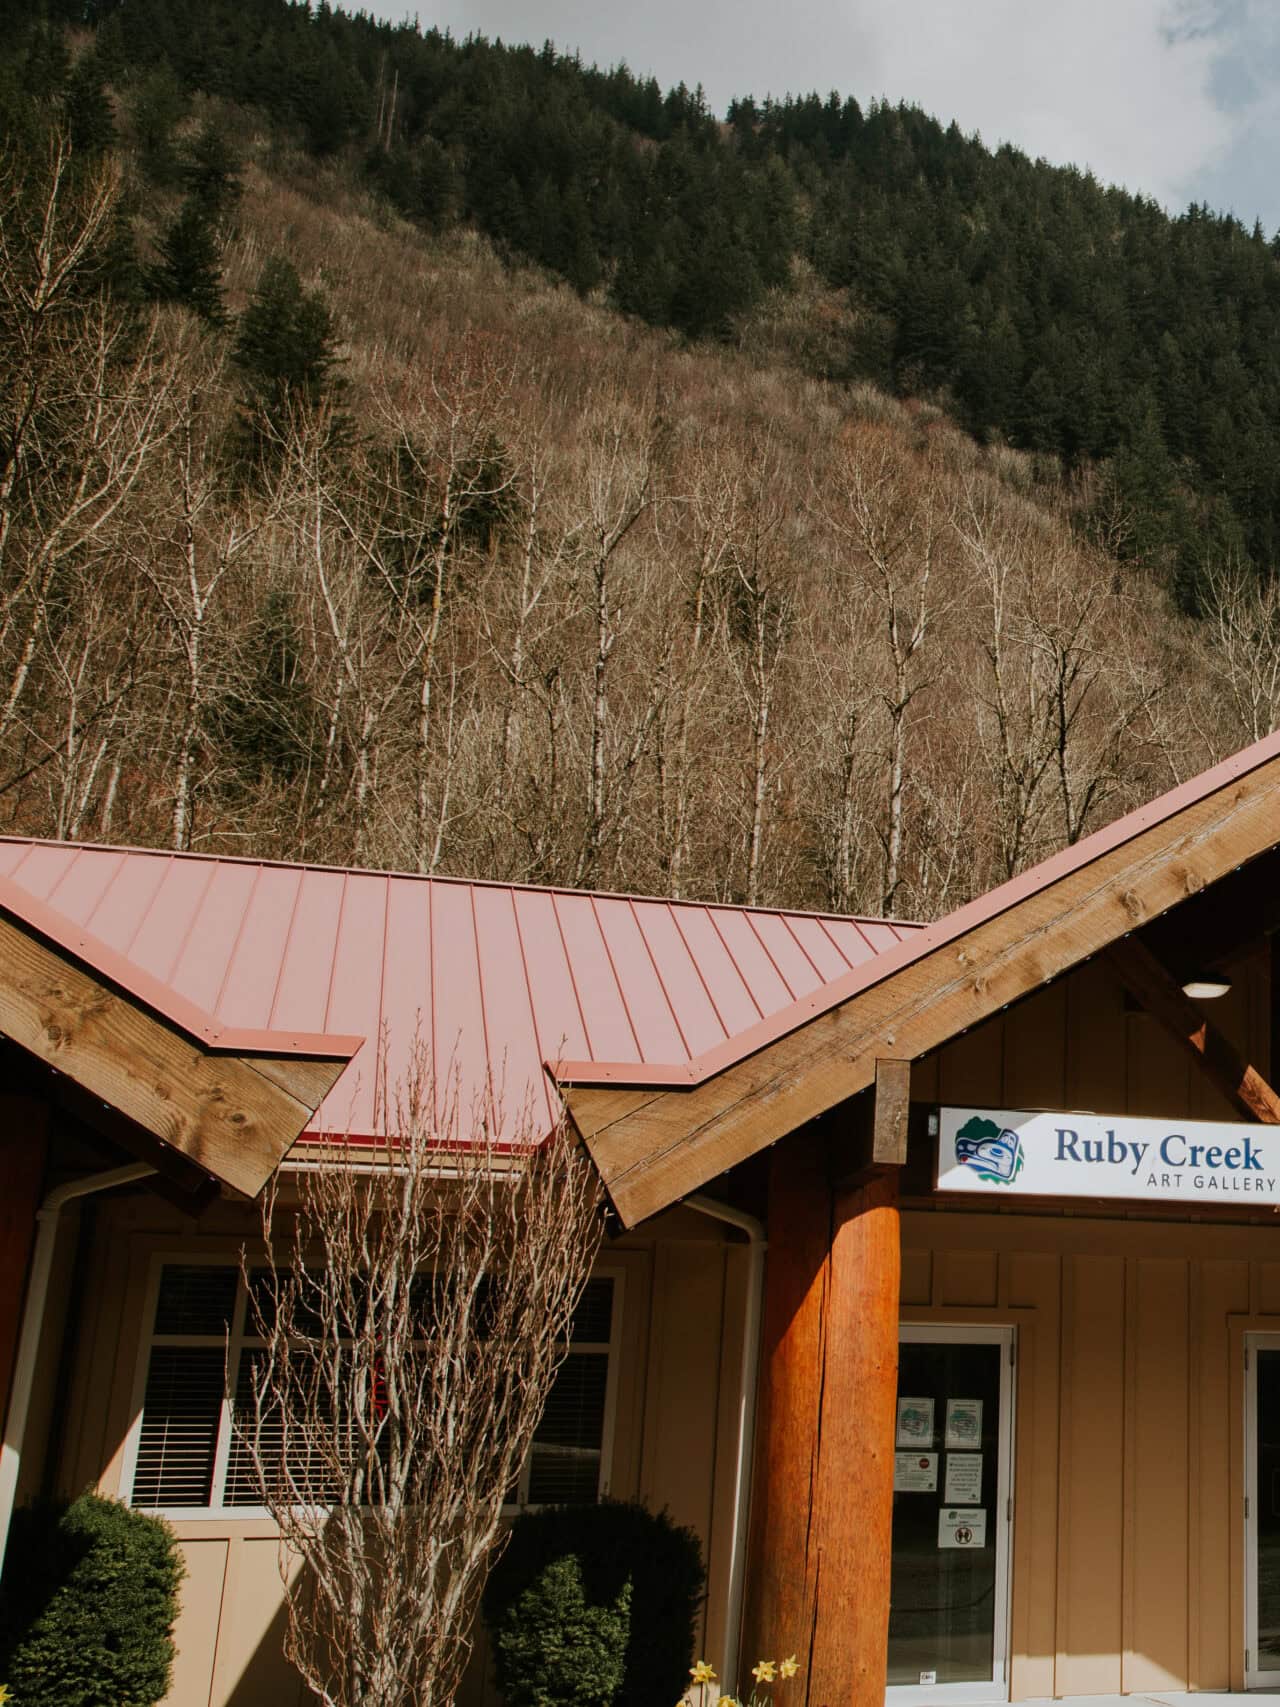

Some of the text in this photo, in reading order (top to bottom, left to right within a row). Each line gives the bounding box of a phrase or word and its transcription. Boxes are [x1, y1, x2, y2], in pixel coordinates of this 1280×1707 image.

[1054, 1128, 1265, 1175] Ruby Creek
[1147, 1173, 1277, 1192] ART GALLERY
